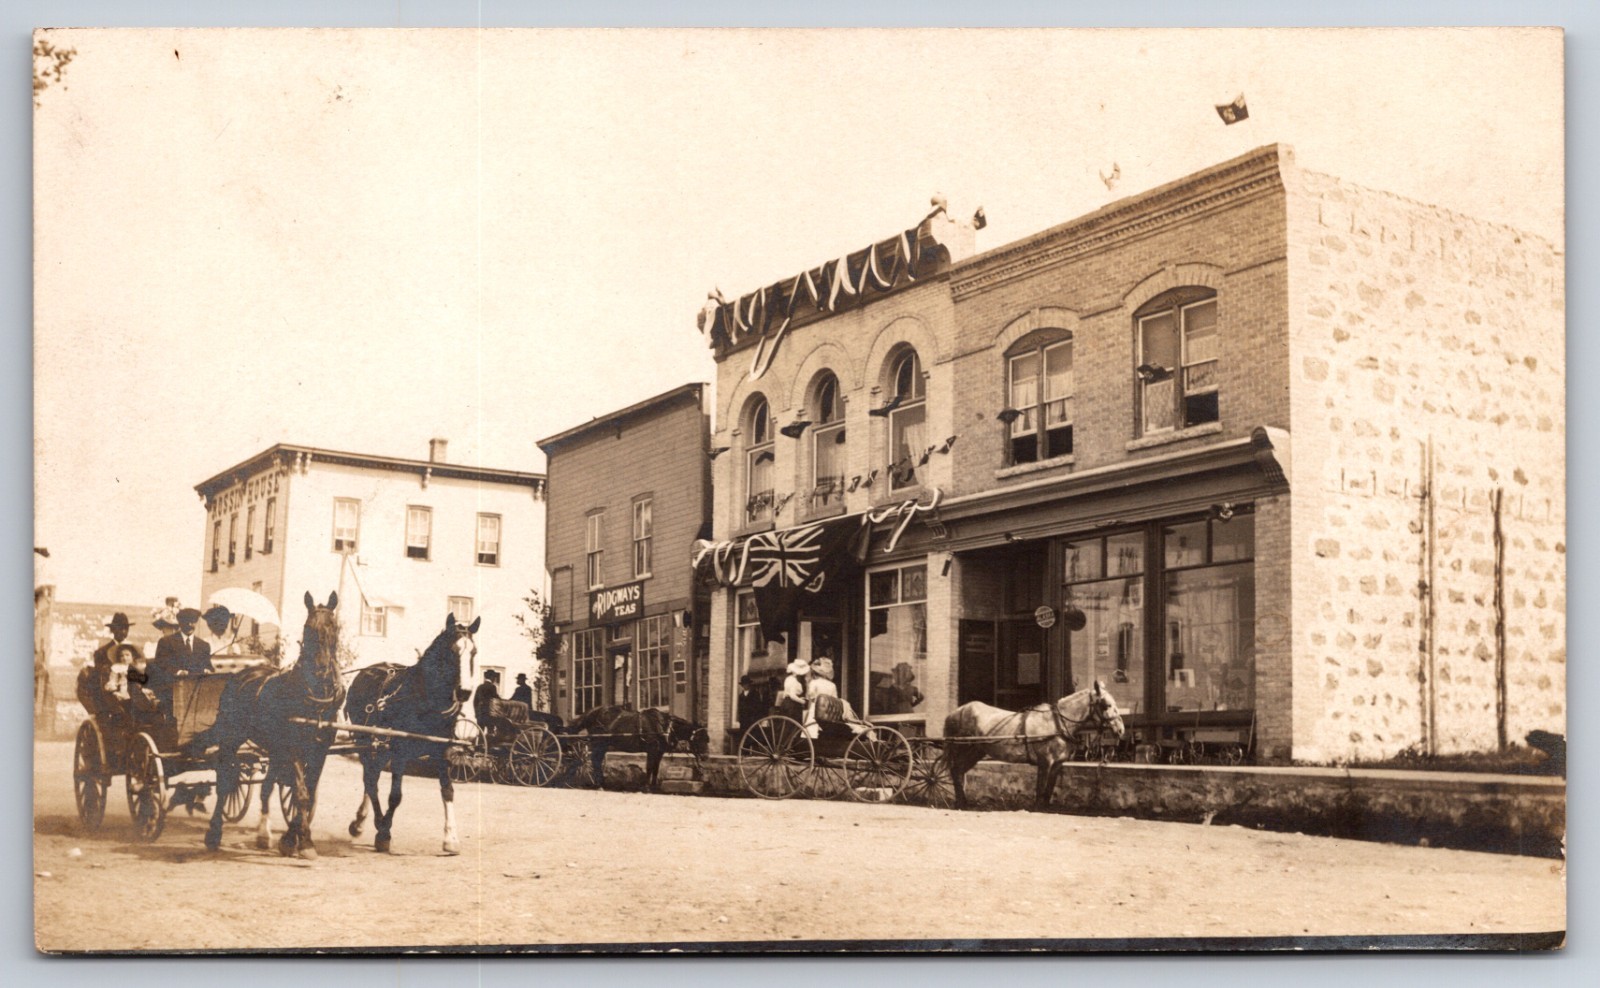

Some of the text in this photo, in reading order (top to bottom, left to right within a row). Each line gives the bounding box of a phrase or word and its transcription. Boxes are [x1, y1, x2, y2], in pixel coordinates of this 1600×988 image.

[248, 471, 280, 503] HOUSE
[593, 585, 640, 619] RIDGWAYS
[614, 603, 636, 617] TEAS
